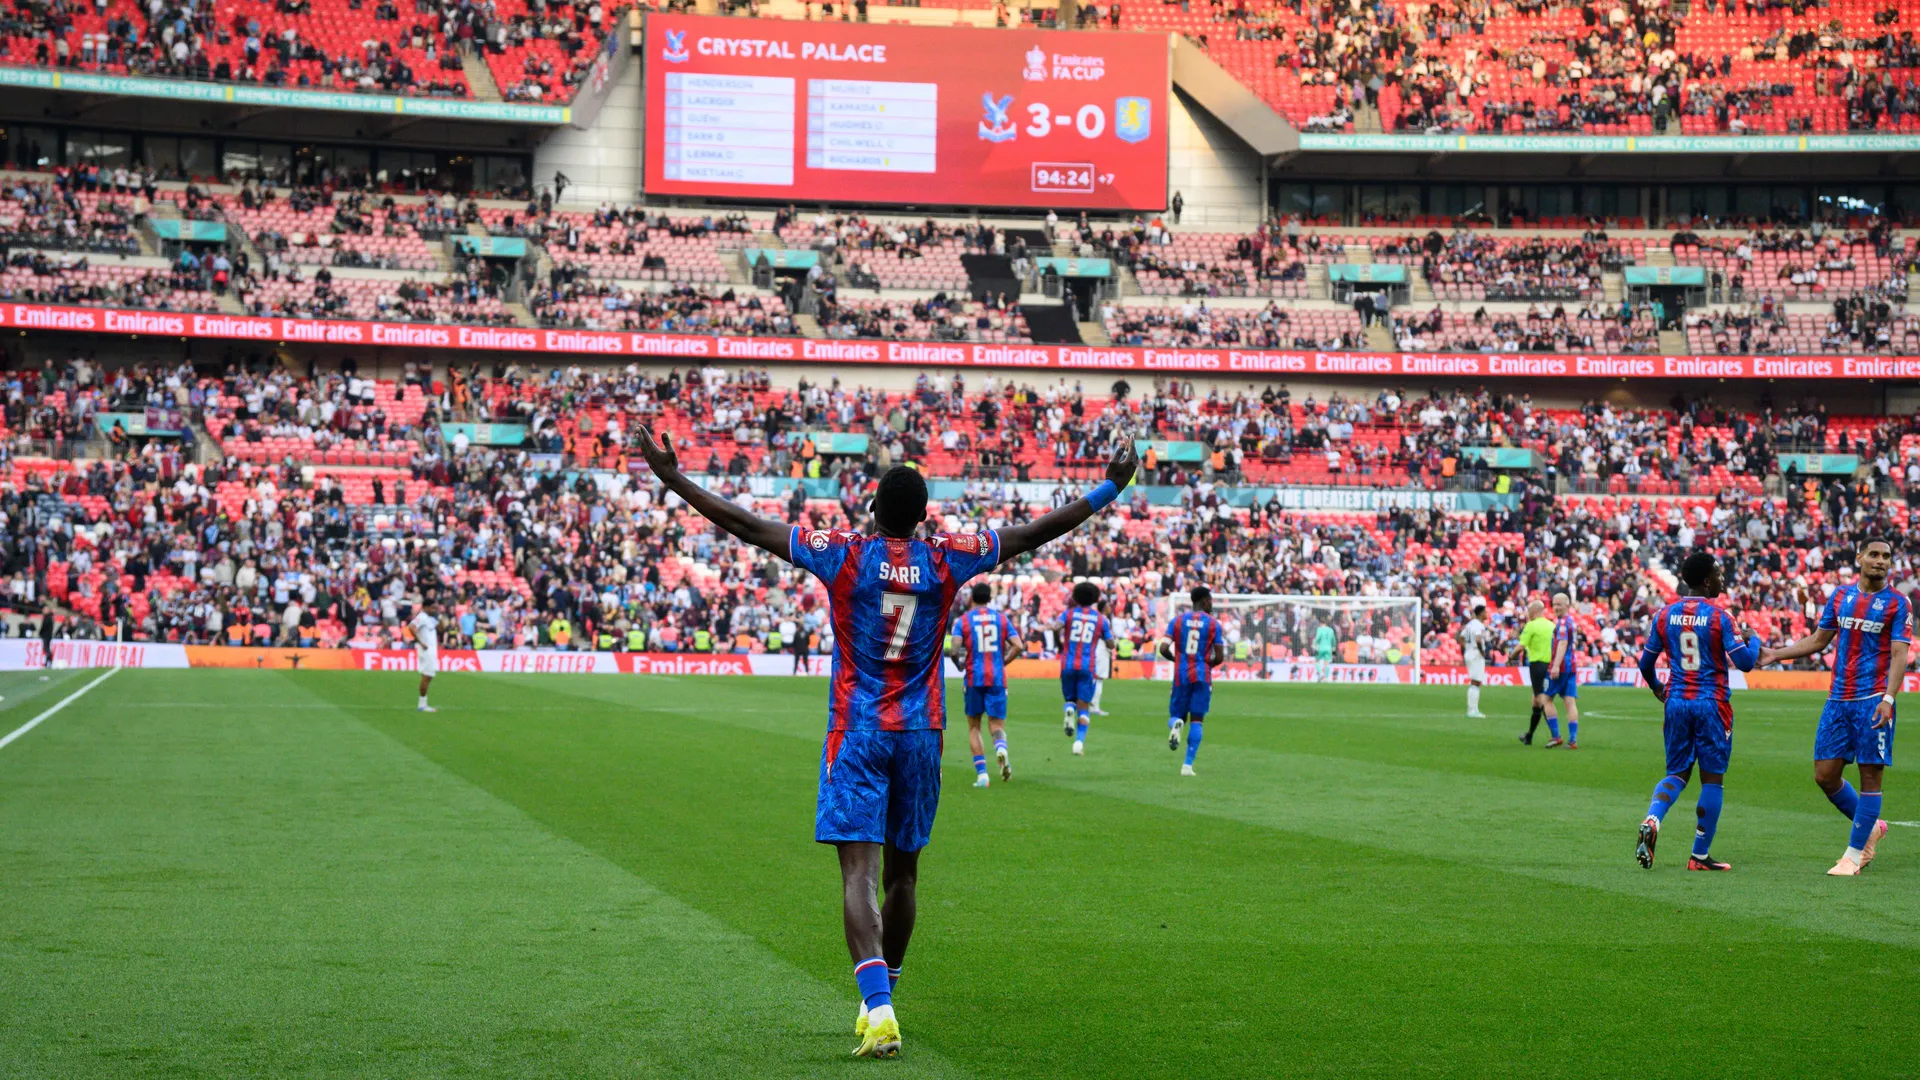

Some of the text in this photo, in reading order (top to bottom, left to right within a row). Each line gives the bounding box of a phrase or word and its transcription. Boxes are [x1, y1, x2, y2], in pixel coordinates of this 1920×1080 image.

[697, 37, 887, 62] CRYSTAL PALACE
[1052, 53, 1105, 67] Emirates
[1052, 67, 1105, 81] FA CUP
[1026, 102, 1105, 139] 3-0
[1037, 170, 1090, 186] 94:24
[15, 306, 94, 328] Emirates
[105, 311, 184, 332] Emirates
[194, 316, 272, 337] Emirates
[283, 320, 362, 341] Emirates
[372, 324, 449, 344] Emirates
[459, 328, 536, 348] Emirates
[546, 332, 622, 350] Emirates
[632, 335, 708, 353] Emirates
[718, 338, 794, 356] Emirates
[803, 341, 879, 359] Emirates
[889, 343, 964, 362] Emirates
[973, 346, 1049, 364] Emirates
[1059, 348, 1134, 366] Emirates
[1144, 350, 1220, 368] Emirates
[1230, 352, 1305, 370] Emirates
[1316, 354, 1392, 371] Emirates
[1402, 355, 1479, 372] Emirates
[1489, 356, 1566, 373] Emirates
[1577, 357, 1654, 374] Emirates
[1665, 357, 1742, 375] Emirates
[1754, 358, 1832, 375] Emirates
[879, 561, 921, 584] SARR
[880, 591, 918, 660] 7
[1669, 614, 1708, 627] NKETIAH
[1837, 616, 1884, 634] NET88
[975, 624, 998, 652] 12
[1070, 620, 1095, 643] 26
[1186, 629, 1200, 654] 6
[363, 652, 478, 671] Emites
[1679, 631, 1701, 671] 9
[535, 655, 596, 673] BETTER
[632, 656, 744, 674] Emirates
[1878, 731, 1886, 751] 5
